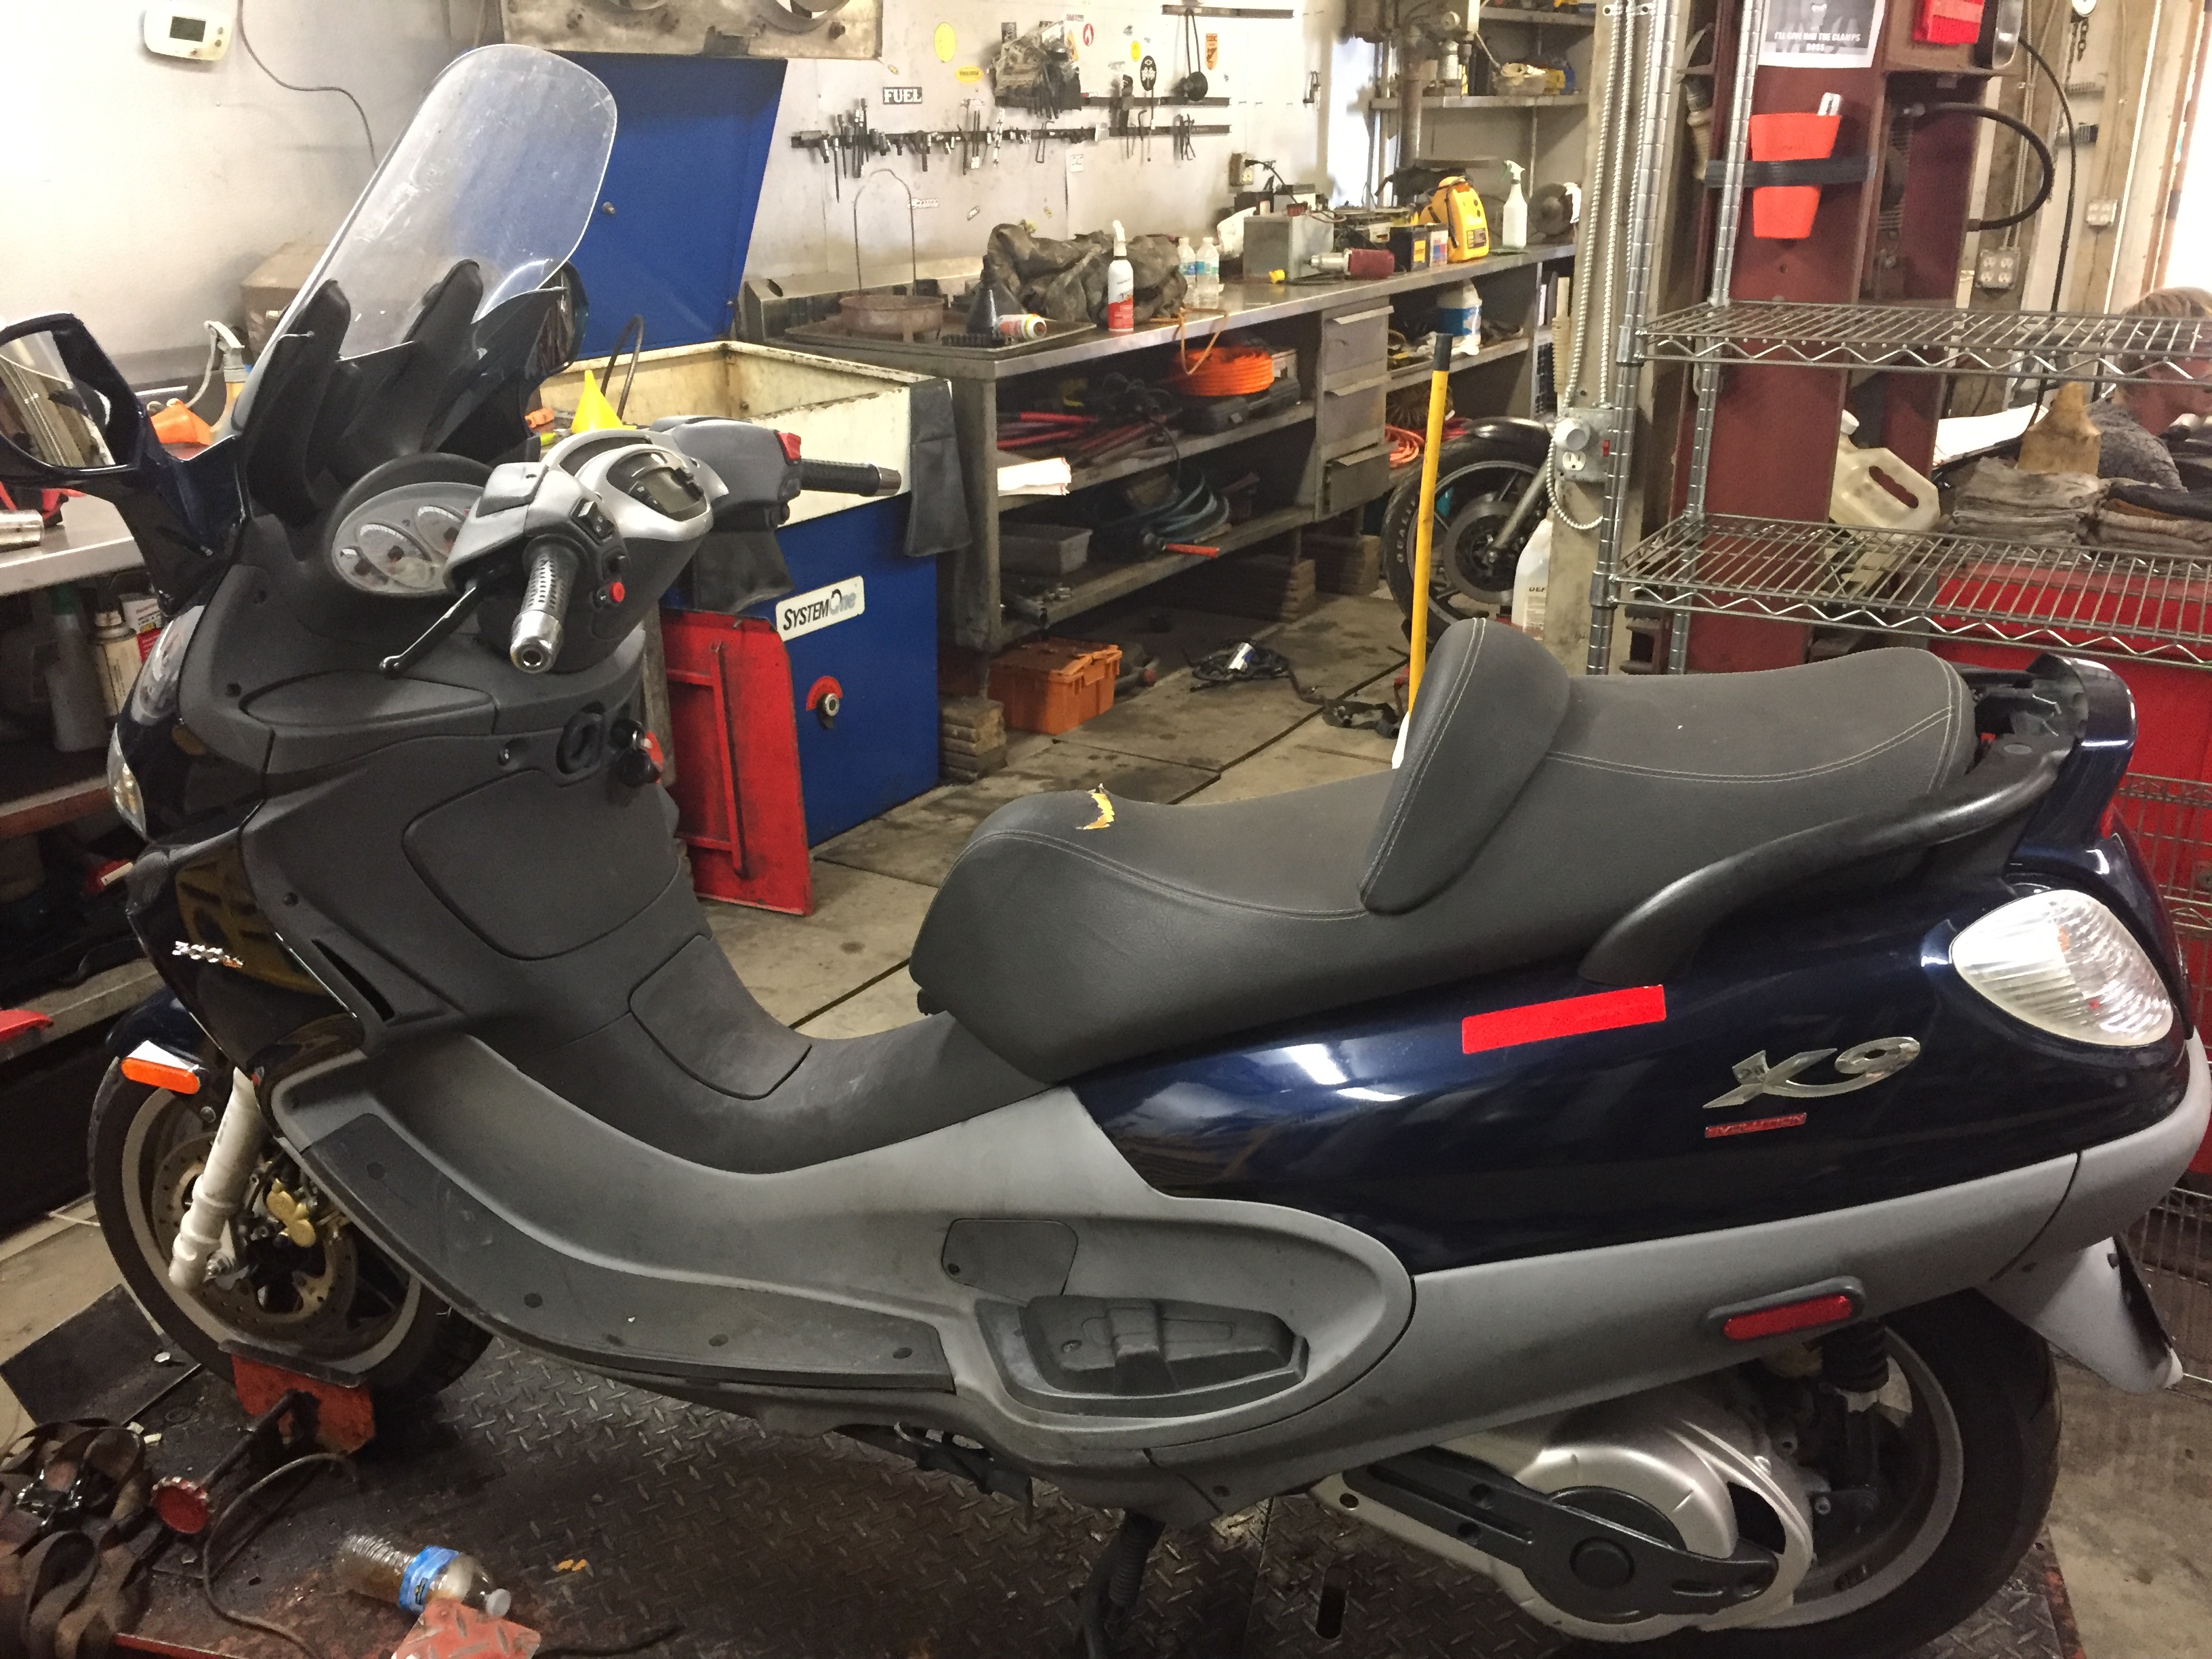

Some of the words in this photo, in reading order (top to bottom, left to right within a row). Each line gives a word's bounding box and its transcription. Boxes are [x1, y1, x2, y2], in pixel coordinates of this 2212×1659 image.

[1818, 33, 1831, 41] THE
[1831, 33, 1861, 42] CLAMPS
[1806, 43, 1825, 52] BOSS
[883, 88, 922, 103] FUEL
